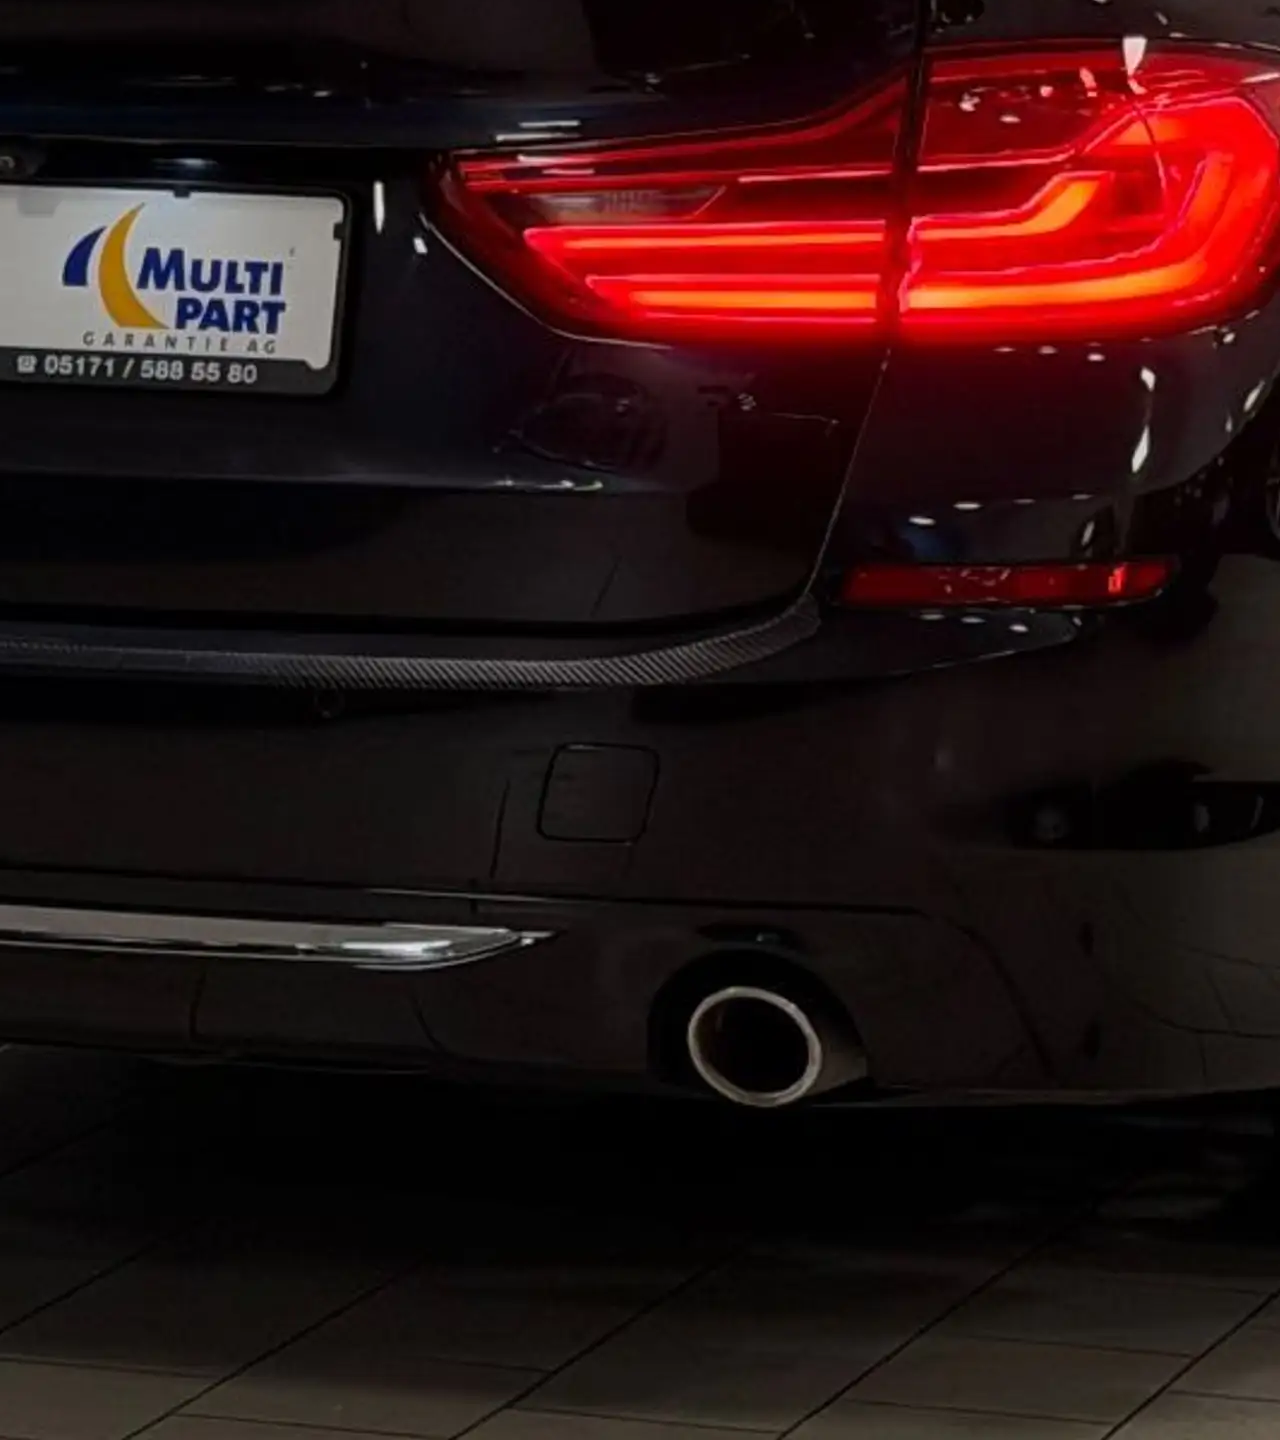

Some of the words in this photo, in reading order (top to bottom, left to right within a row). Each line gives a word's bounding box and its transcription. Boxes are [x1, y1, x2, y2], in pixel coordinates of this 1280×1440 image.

[135, 246, 284, 296] MULTI
[174, 296, 287, 335] PART
[81, 331, 228, 353] GARANTIE
[246, 338, 277, 355] AG
[44, 354, 115, 378] 05171
[122, 357, 135, 379] /
[140, 358, 184, 381] 588
[190, 361, 221, 383] 55
[227, 363, 258, 384] 80
